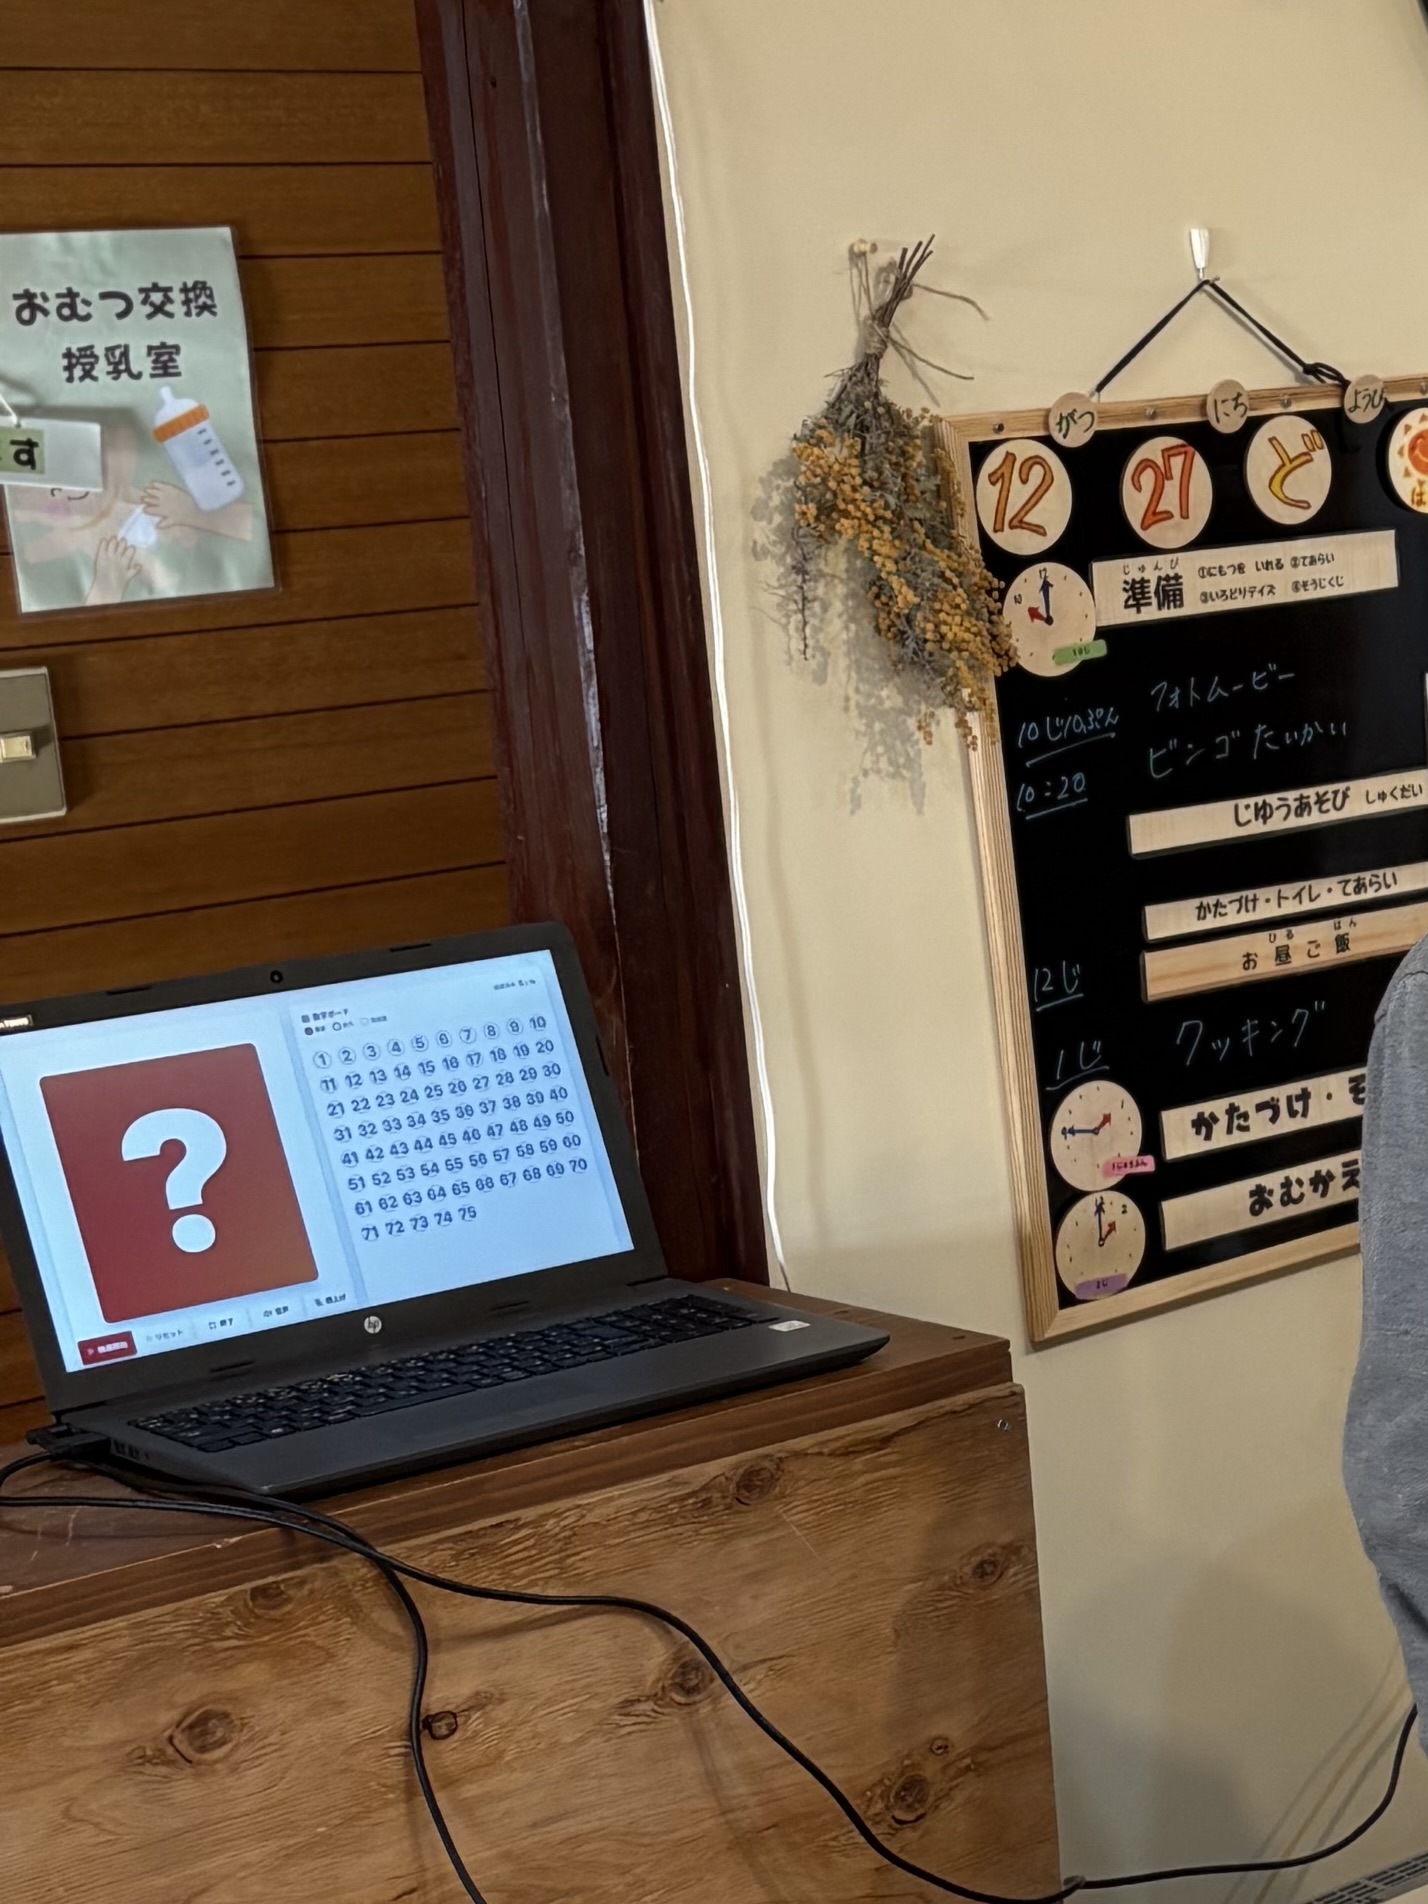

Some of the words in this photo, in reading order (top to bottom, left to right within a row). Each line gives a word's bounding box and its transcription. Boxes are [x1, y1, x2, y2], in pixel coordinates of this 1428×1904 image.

[12, 280, 218, 326] おむつ交換
[61, 341, 182, 383] 授乳室
[1056, 408, 1095, 439] がつ
[1213, 391, 1248, 425] にち
[988, 450, 1054, 537] 12
[1131, 443, 1196, 531] 27
[1268, 429, 1325, 510] ど
[1122, 556, 1180, 576] じゅんび
[1255, 558, 1284, 572] いれる
[1122, 573, 1185, 614] 準備
[1233, 787, 1350, 828] じゆうあそび
[1365, 782, 1424, 806] しゅくだい
[1195, 871, 1399, 922] かたづけ・トイレ・てあらい
[1242, 934, 1352, 971] お昼ご飯
[1176, 1000, 1327, 1066] クッキング
[120, 1106, 228, 1254] ?
[1249, 1158, 1360, 1218] おむかえ
